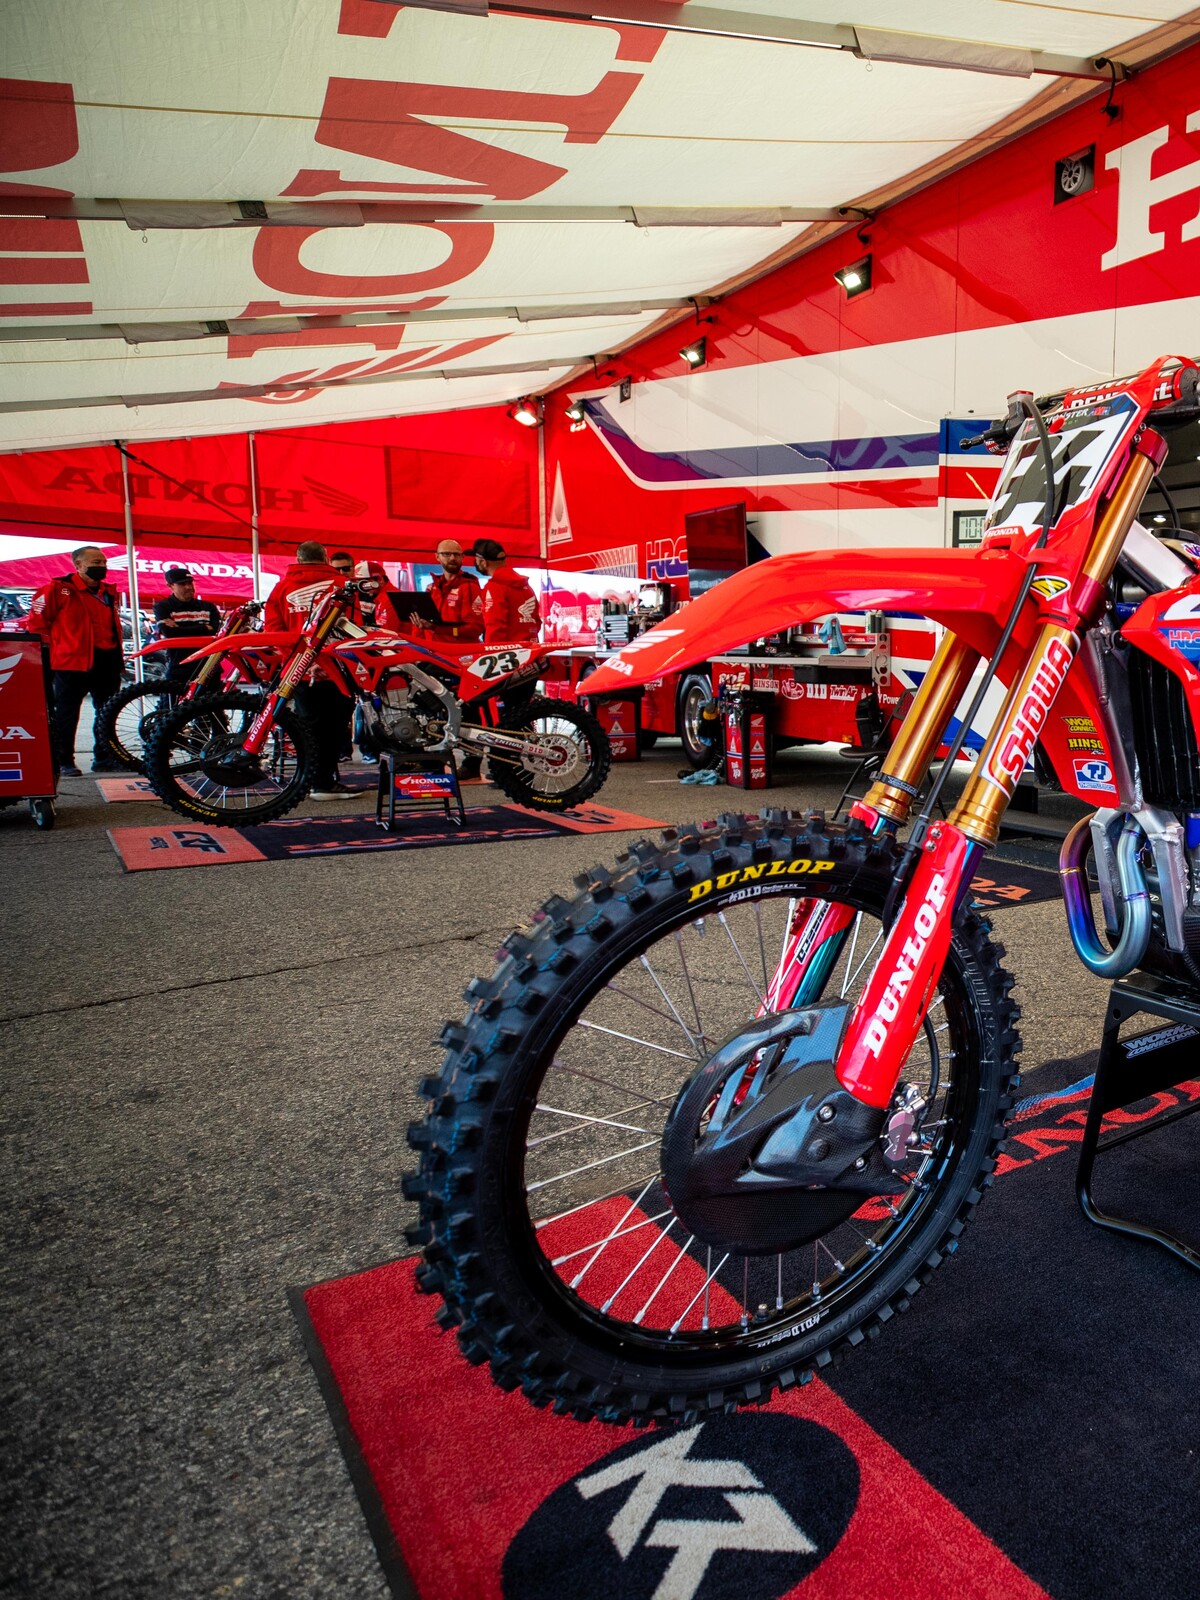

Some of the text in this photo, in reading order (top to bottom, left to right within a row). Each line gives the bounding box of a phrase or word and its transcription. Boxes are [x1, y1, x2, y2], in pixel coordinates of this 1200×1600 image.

[987, 527, 1019, 538] HONDA
[135, 558, 255, 579] HONDA
[645, 534, 689, 581] HRC
[478, 651, 521, 680] 23
[998, 638, 1072, 784] SHOWA
[410, 777, 451, 785] HONDA
[687, 858, 836, 904] DUNLOP
[863, 873, 947, 1059] DUNLOP
